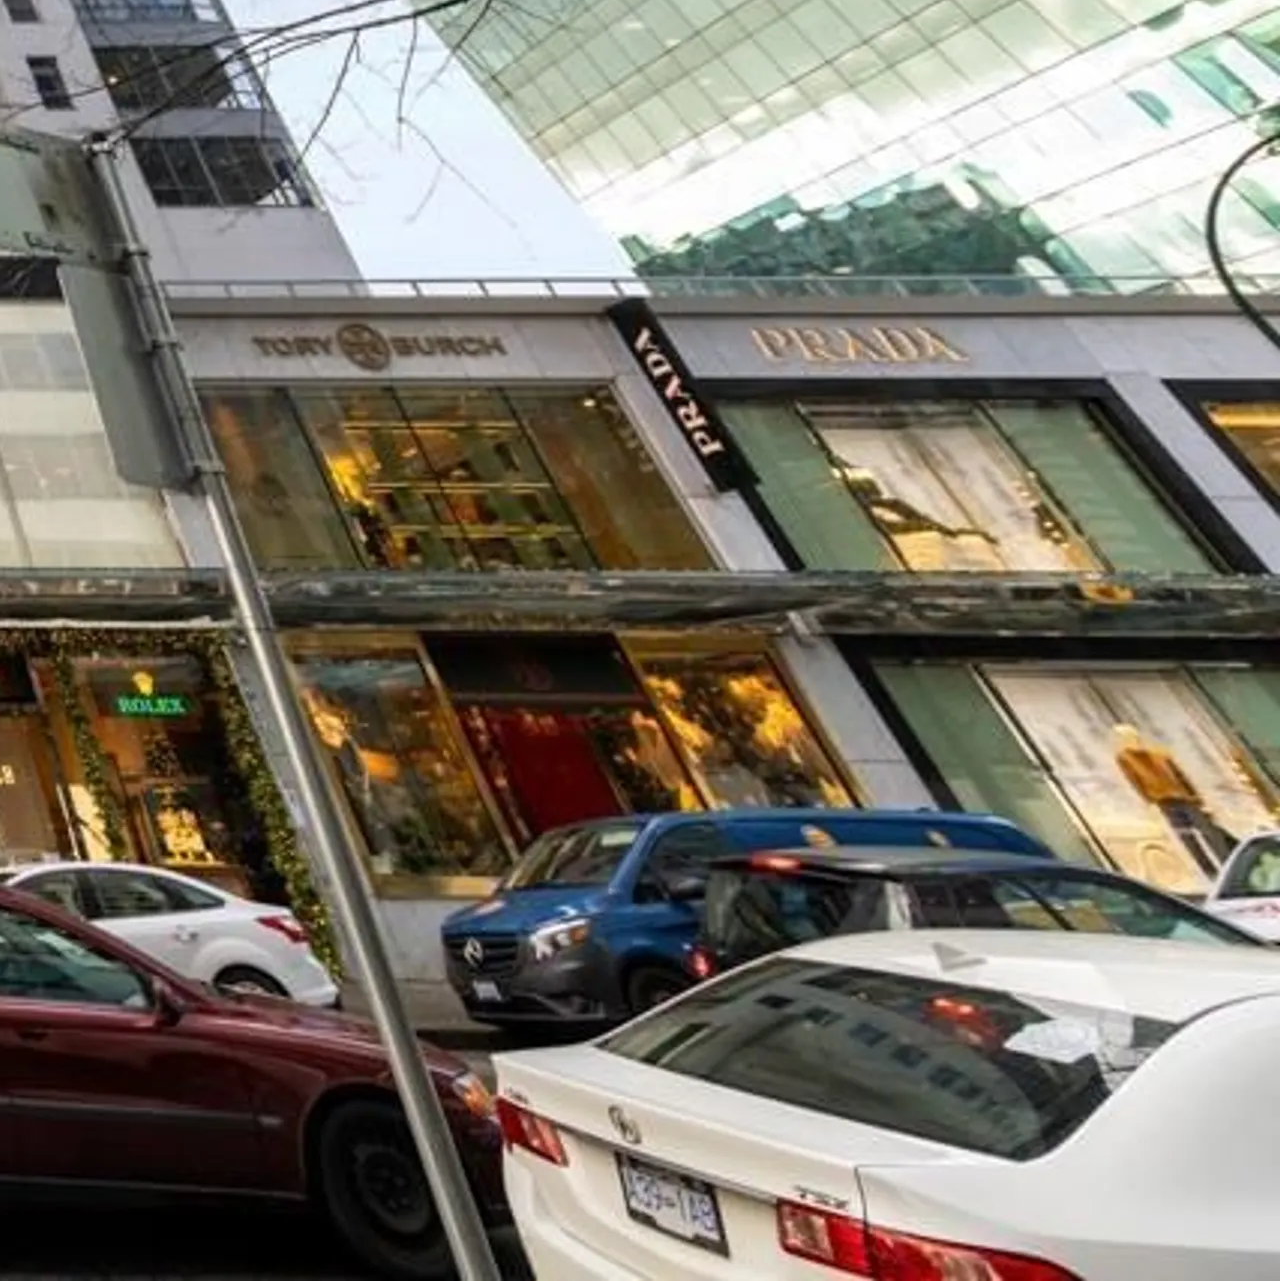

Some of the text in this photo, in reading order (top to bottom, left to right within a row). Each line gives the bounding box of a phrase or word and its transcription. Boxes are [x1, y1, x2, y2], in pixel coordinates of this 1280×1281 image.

[251, 336, 507, 356] TORY BURCH
[751, 327, 970, 362] PRADA
[634, 327, 725, 455] PRADA
[118, 696, 186, 714] ROLEX
